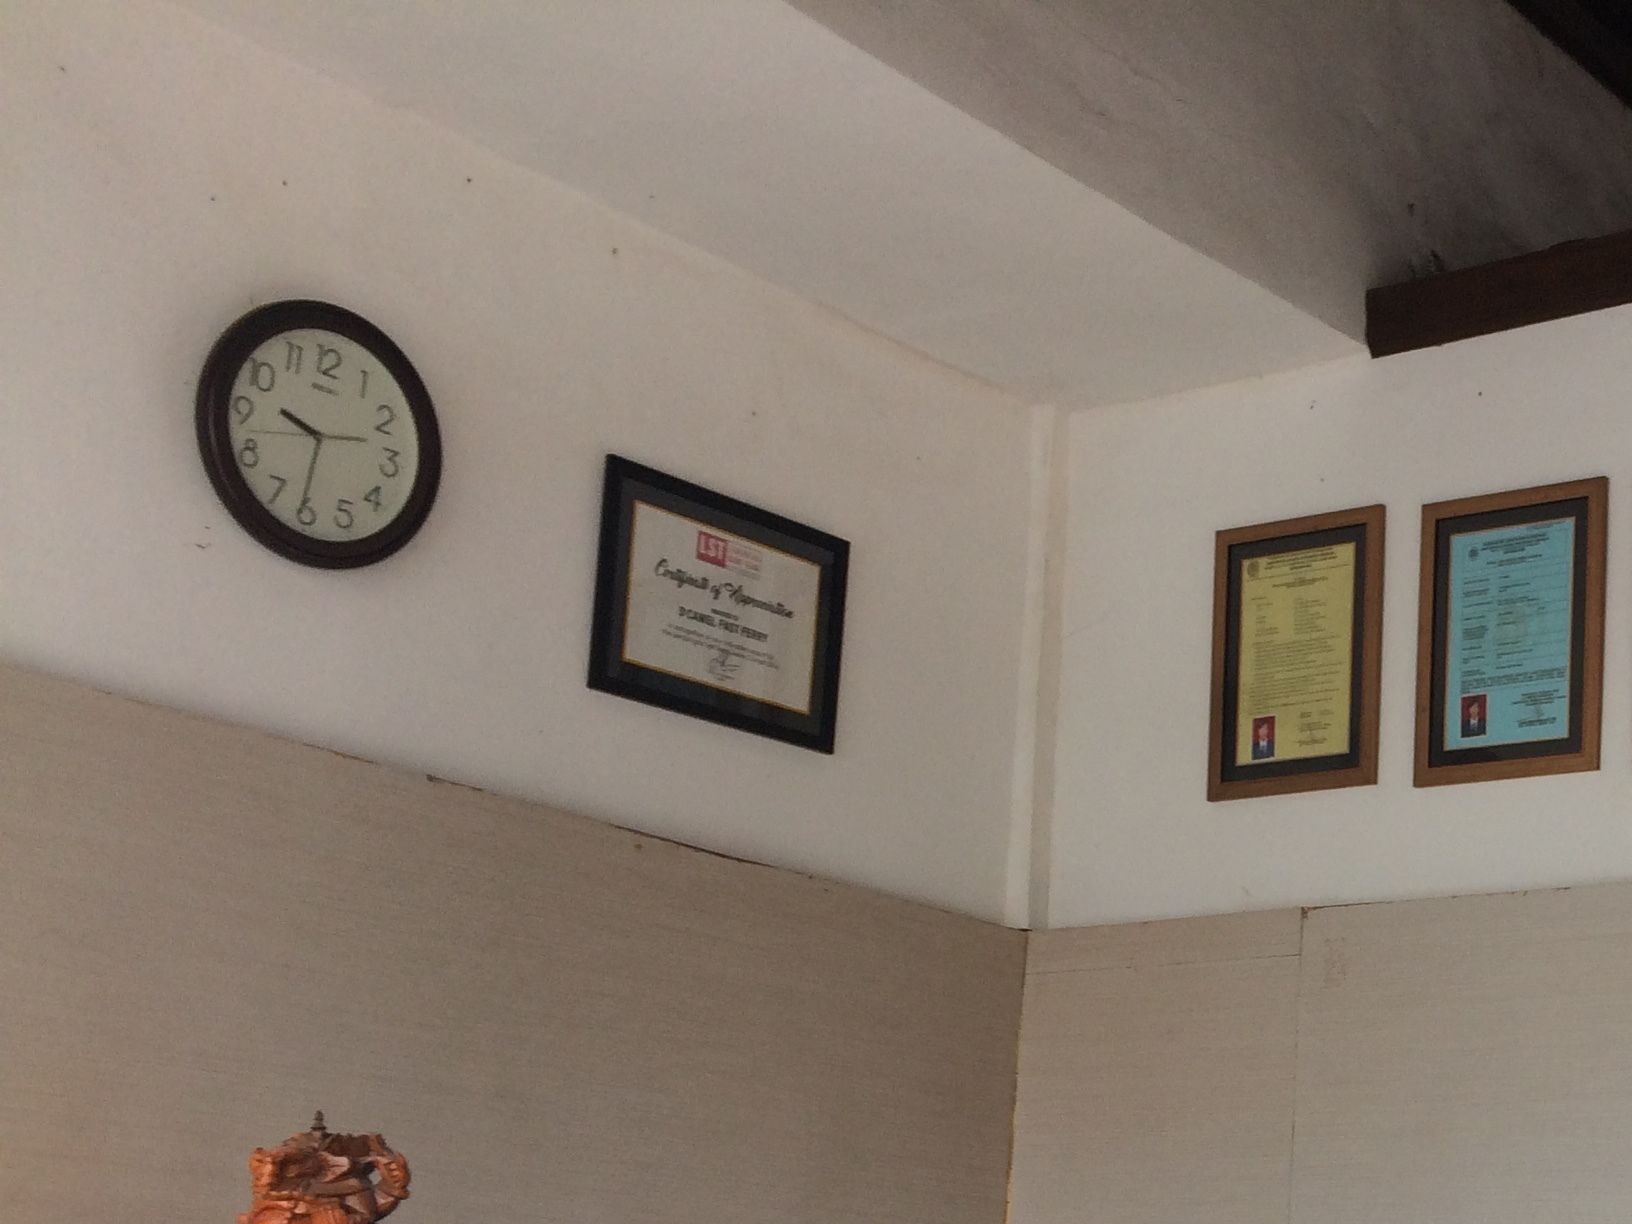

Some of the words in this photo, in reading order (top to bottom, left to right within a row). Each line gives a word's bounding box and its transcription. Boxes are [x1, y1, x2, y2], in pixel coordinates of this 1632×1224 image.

[286, 341, 303, 374] 11
[317, 344, 342, 380] 12
[250, 357, 275, 391] 10
[360, 370, 369, 398] 1
[234, 396, 253, 424] 9
[374, 405, 395, 435] 2
[240, 439, 258, 468] 8
[379, 447, 400, 478] 3
[269, 475, 287, 504] 7
[365, 486, 381, 512] 4
[297, 498, 316, 526] 6
[333, 500, 353, 528] 5
